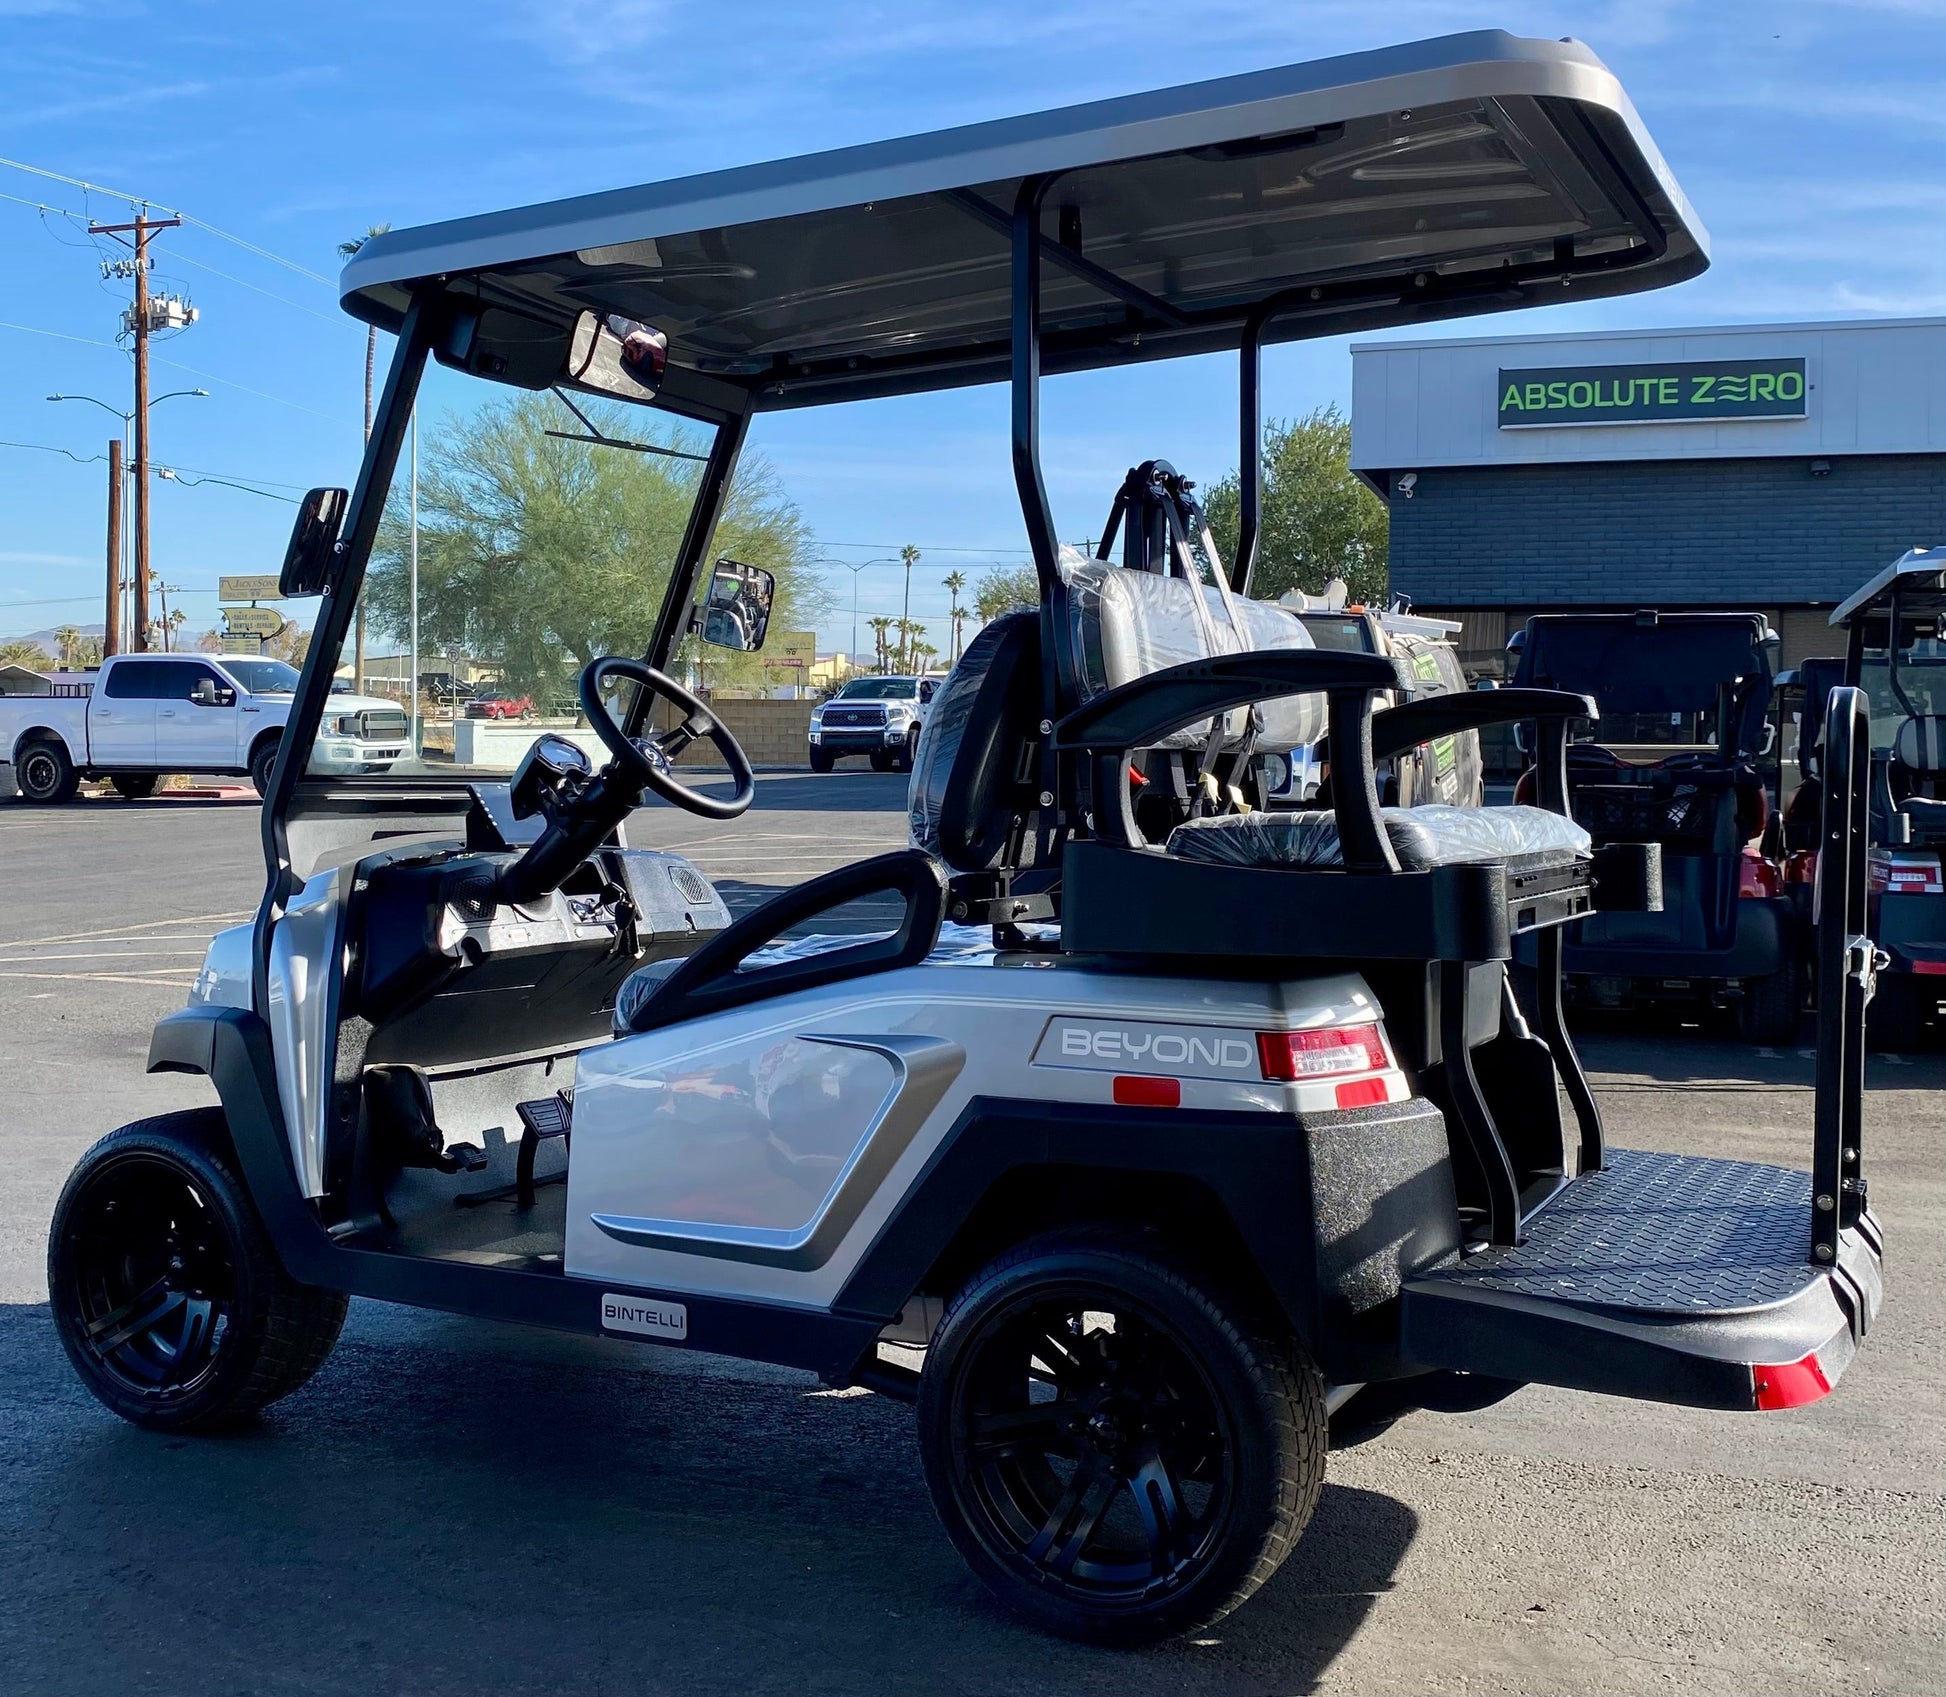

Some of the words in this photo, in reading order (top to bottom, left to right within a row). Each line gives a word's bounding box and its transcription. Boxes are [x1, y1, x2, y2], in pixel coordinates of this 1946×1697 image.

[1500, 377, 1679, 411] ABSOLUTE
[1062, 1028, 1253, 1068] BEYOND
[605, 1304, 683, 1329] BINTELLI
